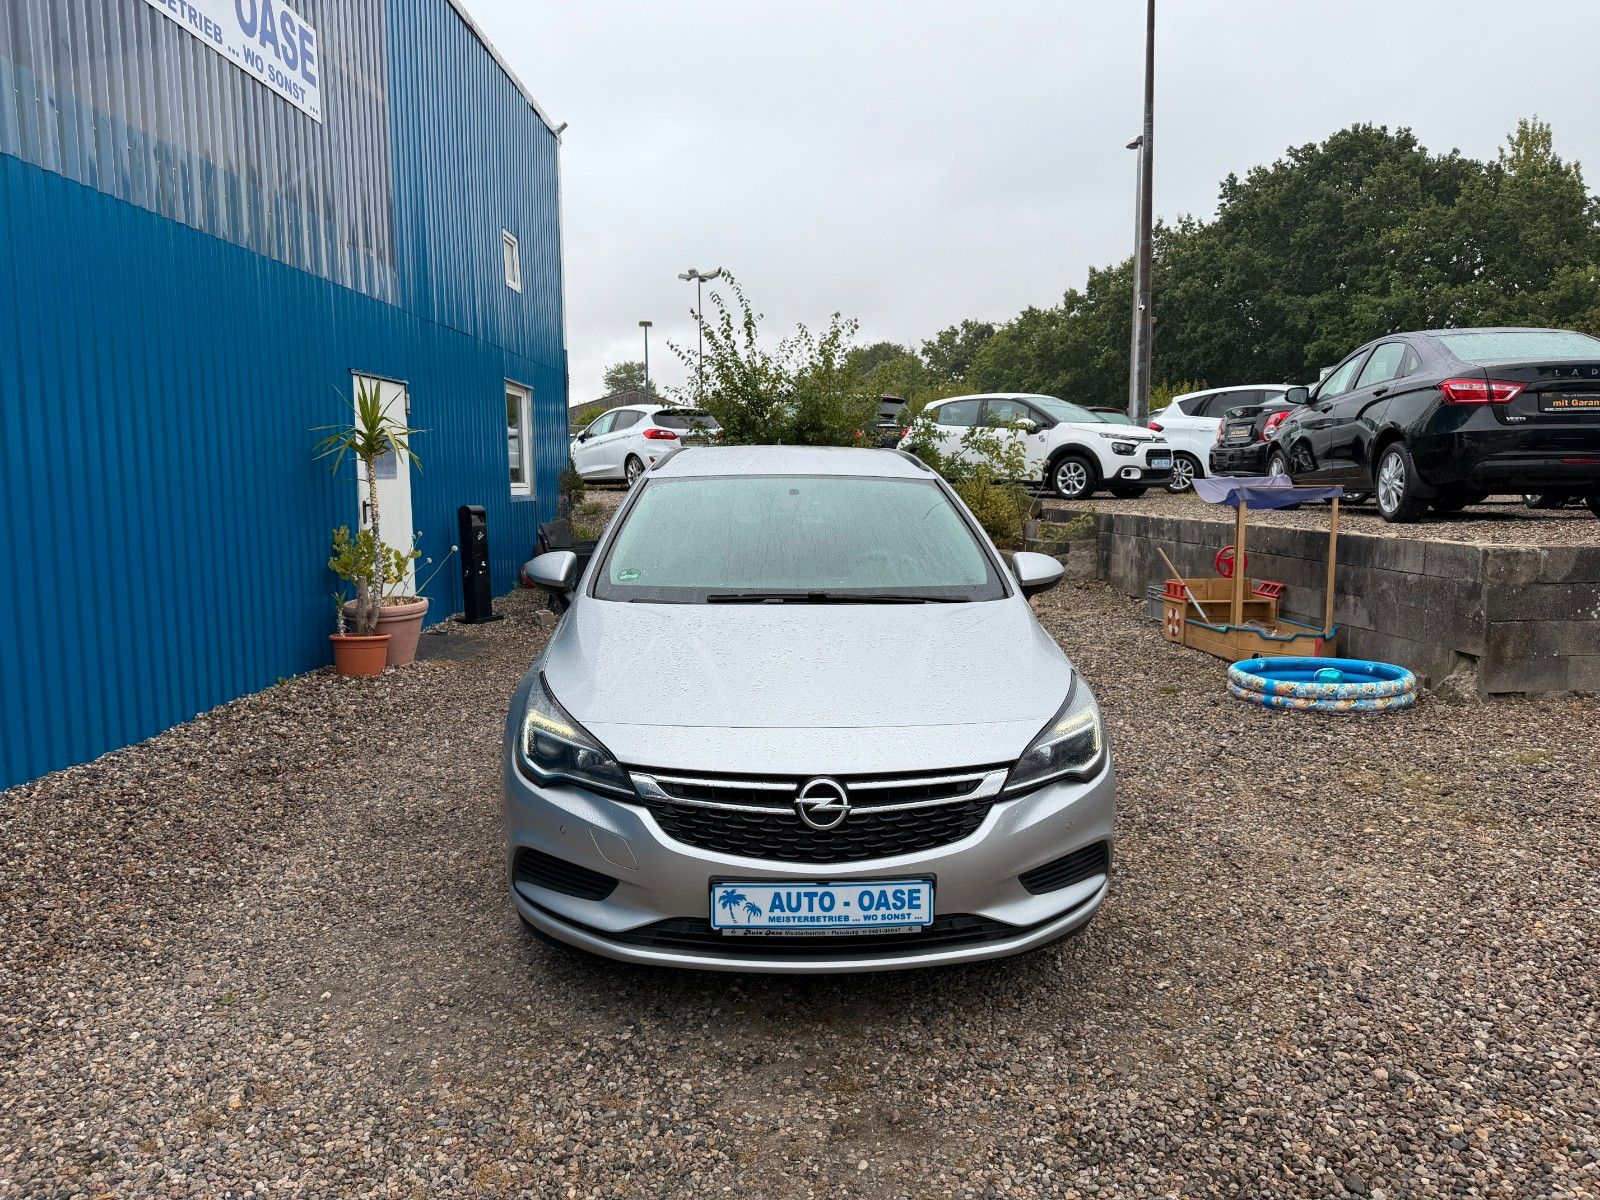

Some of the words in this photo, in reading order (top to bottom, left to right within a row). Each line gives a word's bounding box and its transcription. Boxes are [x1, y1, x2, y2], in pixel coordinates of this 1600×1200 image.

[158, 0, 223, 45] ETRIEB
[243, 44, 264, 74] WO
[268, 63, 306, 104] SONST
[1552, 399, 1569, 407] mit
[768, 891, 836, 913] AUTO
[858, 888, 922, 912] OASE
[768, 914, 850, 923] MEISTERBETRIEB
[863, 914, 879, 922] WO
[880, 912, 912, 921] SONST
